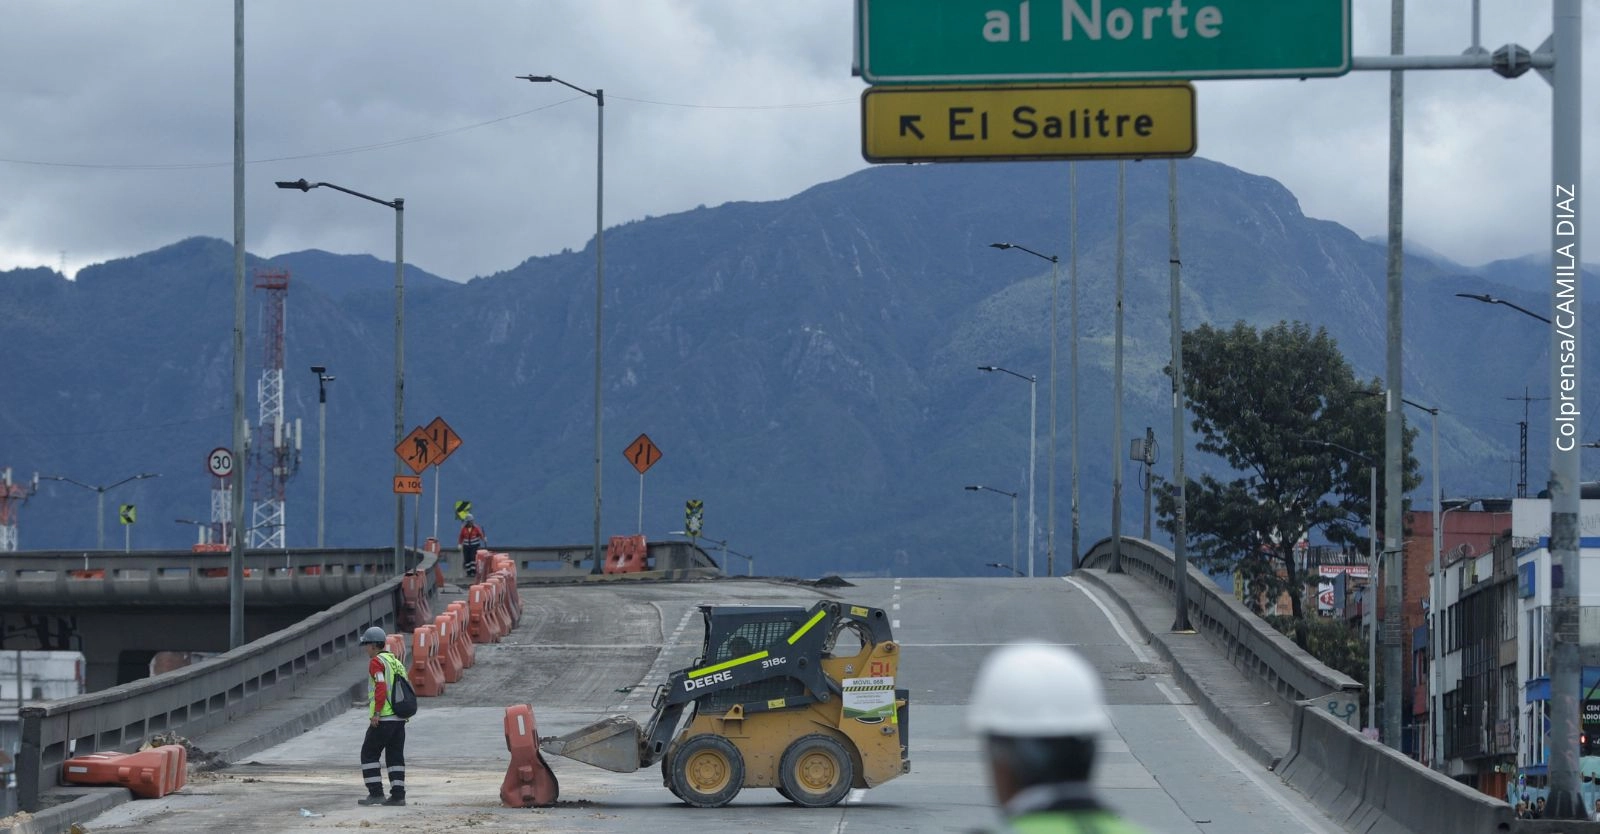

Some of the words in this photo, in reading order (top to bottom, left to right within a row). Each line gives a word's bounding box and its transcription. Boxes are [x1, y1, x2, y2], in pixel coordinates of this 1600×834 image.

[982, 1, 1030, 42] al
[1062, 0, 1224, 40] Norte
[949, 107, 988, 140] El
[1012, 105, 1154, 140] Salitre
[212, 455, 231, 470] 30
[397, 480, 405, 488] A
[761, 657, 787, 669] 318G
[683, 670, 733, 692] DEERE
